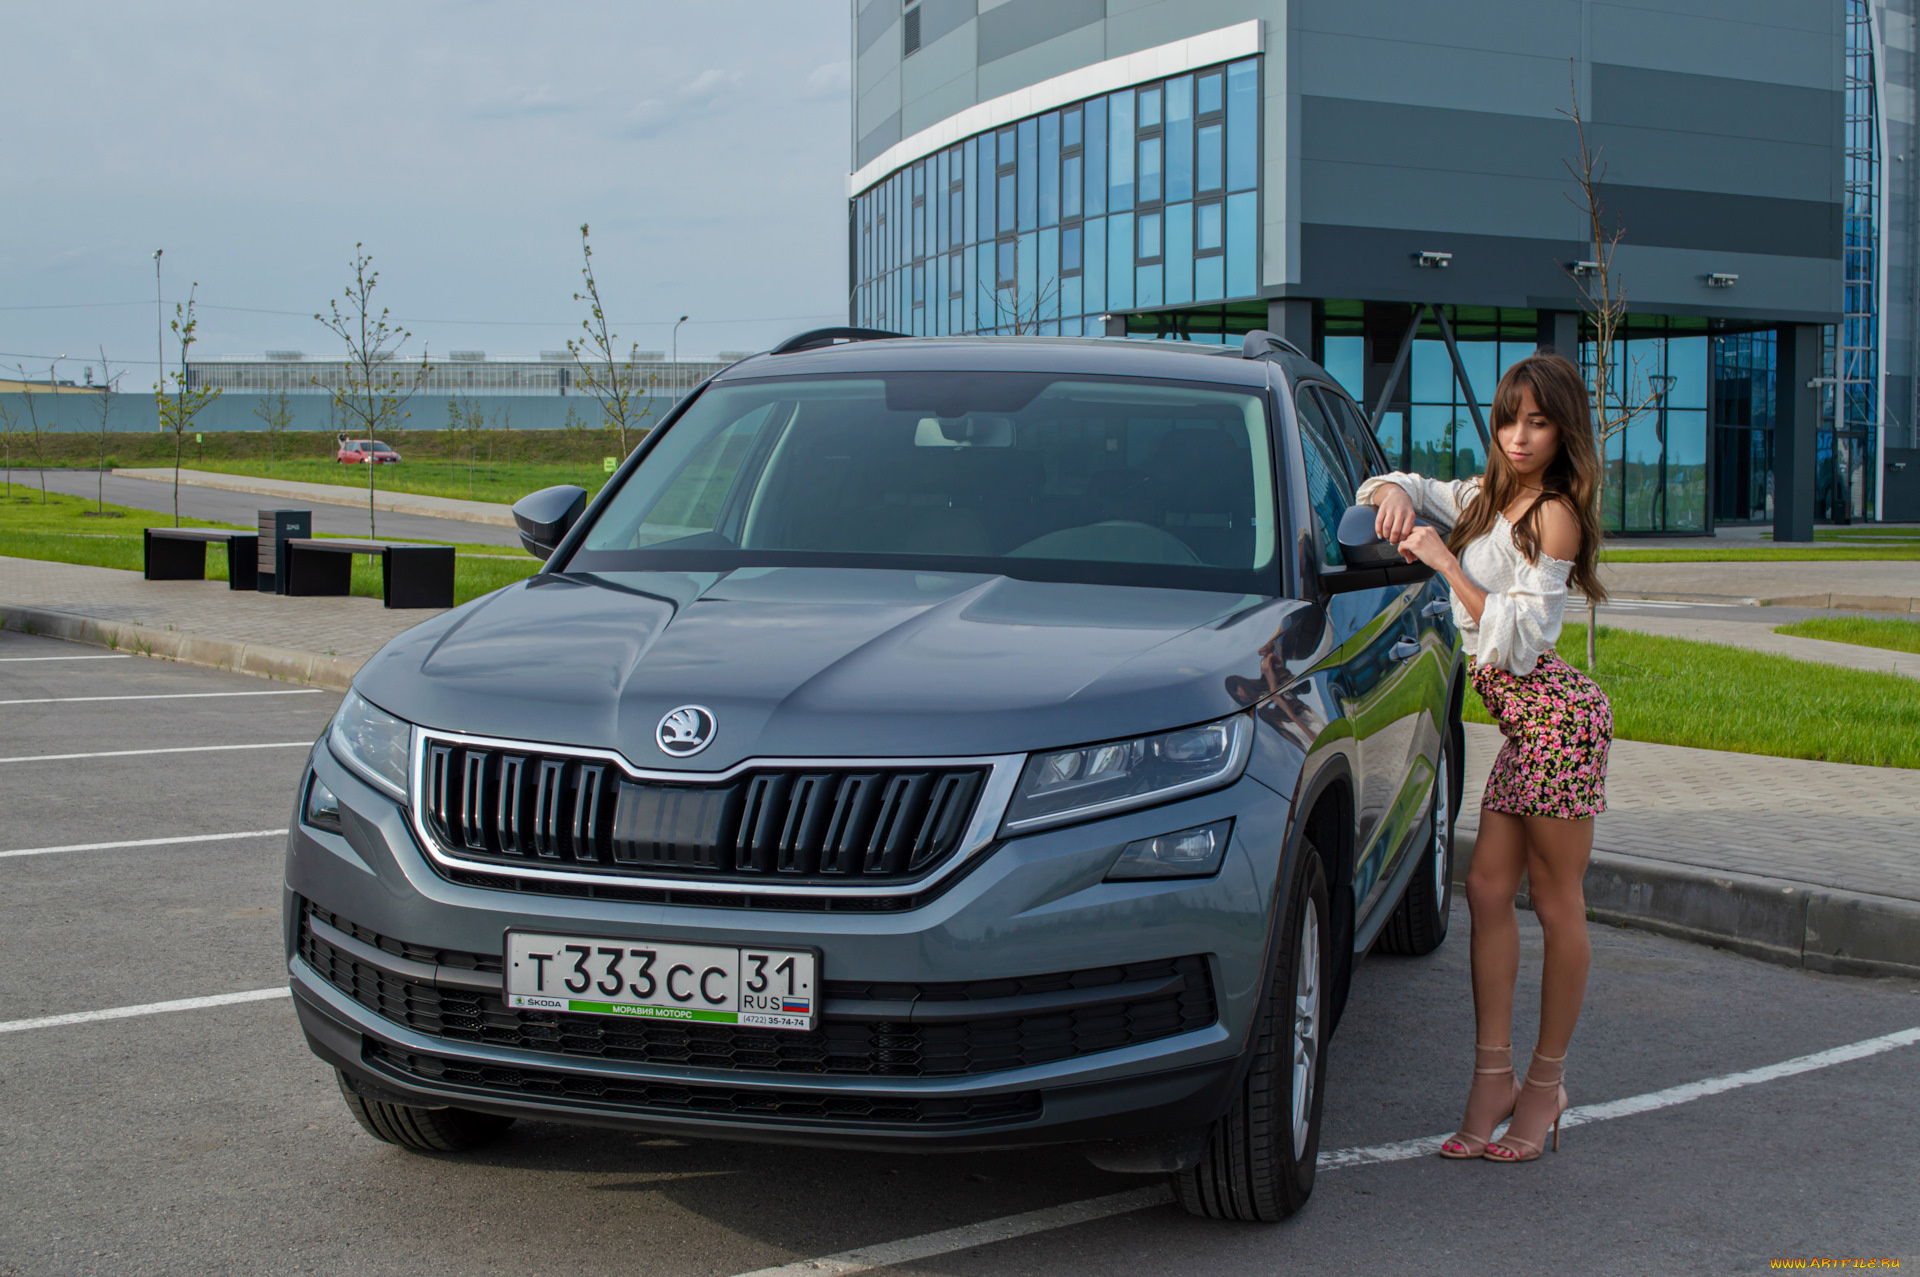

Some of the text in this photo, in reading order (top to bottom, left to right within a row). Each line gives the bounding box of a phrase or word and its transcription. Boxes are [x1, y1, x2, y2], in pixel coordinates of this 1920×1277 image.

[746, 954, 795, 996] 31
[744, 994, 780, 1010] RUS
[612, 1005, 692, 1019] МОРАВИЯ МОТОРС
[743, 1014, 804, 1026] (4722) 35-74-74
